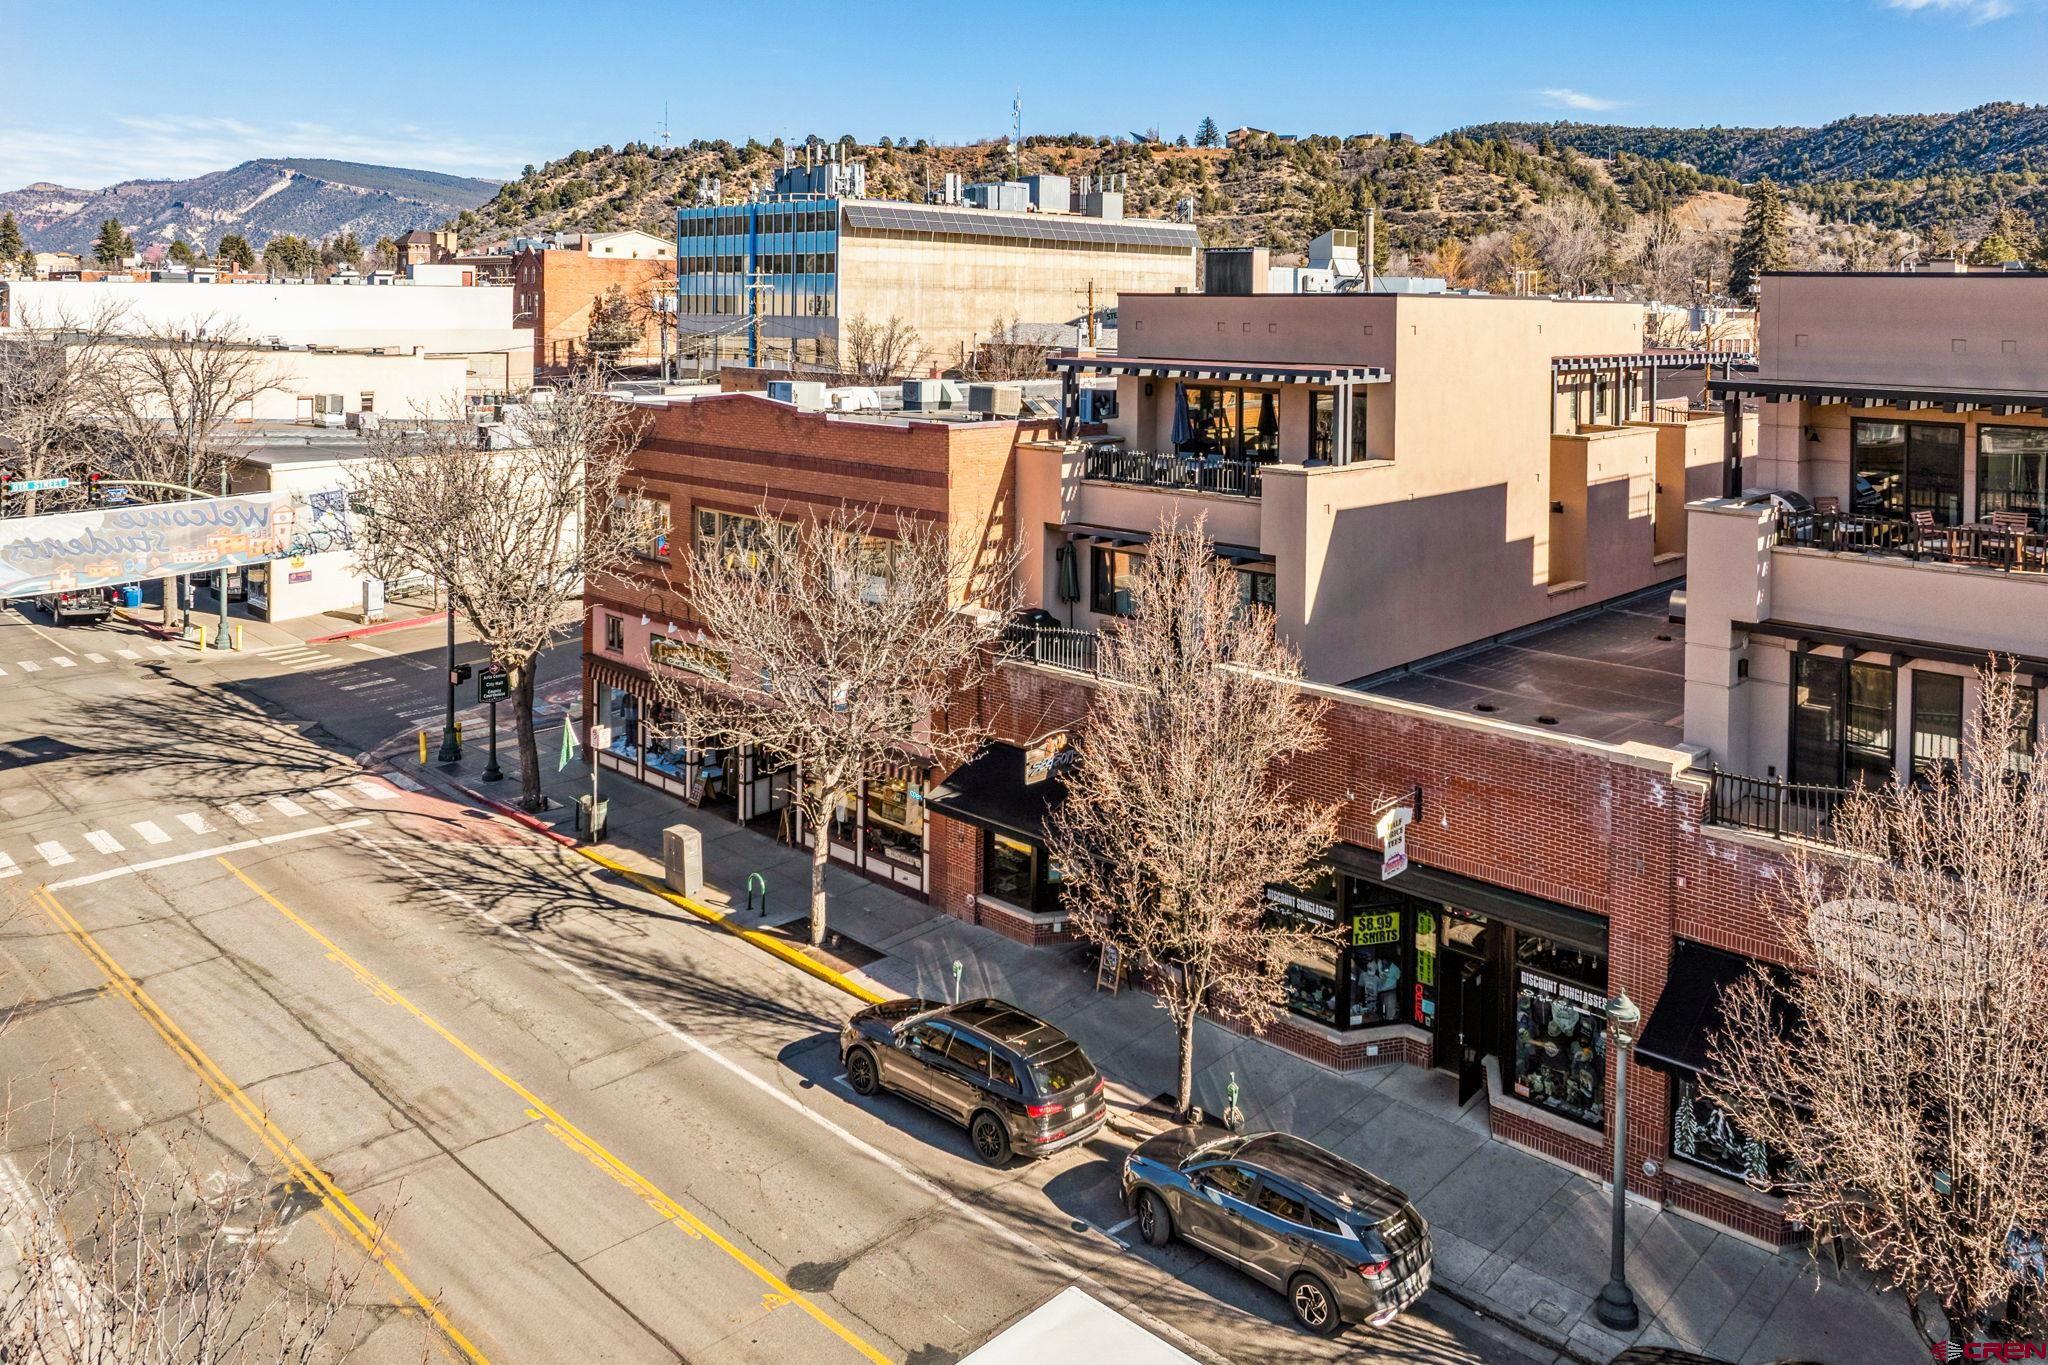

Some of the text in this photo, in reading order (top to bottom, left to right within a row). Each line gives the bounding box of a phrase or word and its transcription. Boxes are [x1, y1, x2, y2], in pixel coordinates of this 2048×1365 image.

[34, 480, 62, 489] STREET
[1388, 836, 1403, 848] TEES
[1267, 888, 1295, 908] DISCOUNT
[1297, 898, 1335, 920] SUNGLASSES
[1358, 915, 1393, 932] $8.99
[1355, 929, 1398, 945] T-SHIRTS
[1520, 971, 1558, 994] DISCOUNT
[1559, 983, 1607, 1010] SUNGLASSES
